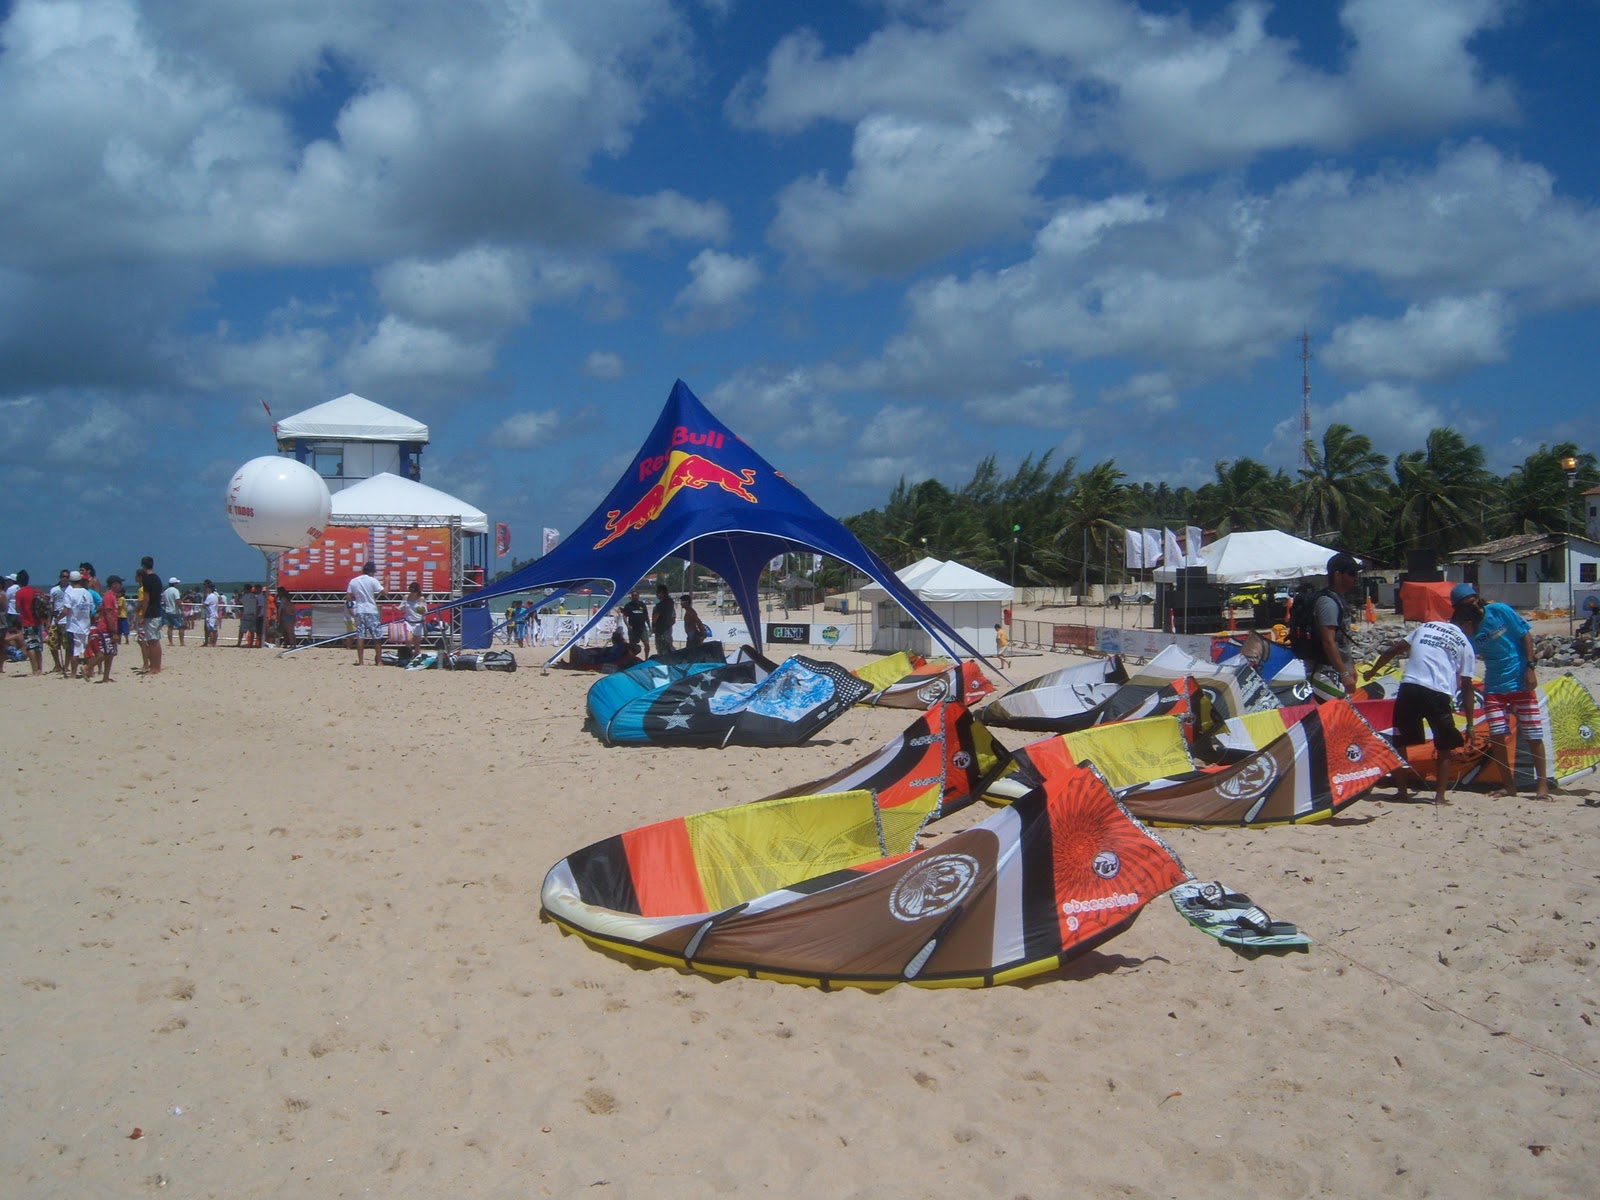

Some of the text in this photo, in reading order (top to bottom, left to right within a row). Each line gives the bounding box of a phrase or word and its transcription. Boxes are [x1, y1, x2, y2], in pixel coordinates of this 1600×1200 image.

[672, 425, 725, 449] Bull
[234, 505, 254, 518] TODOS
[1063, 892, 1139, 914] obsession
[1066, 916, 1079, 931] 9
